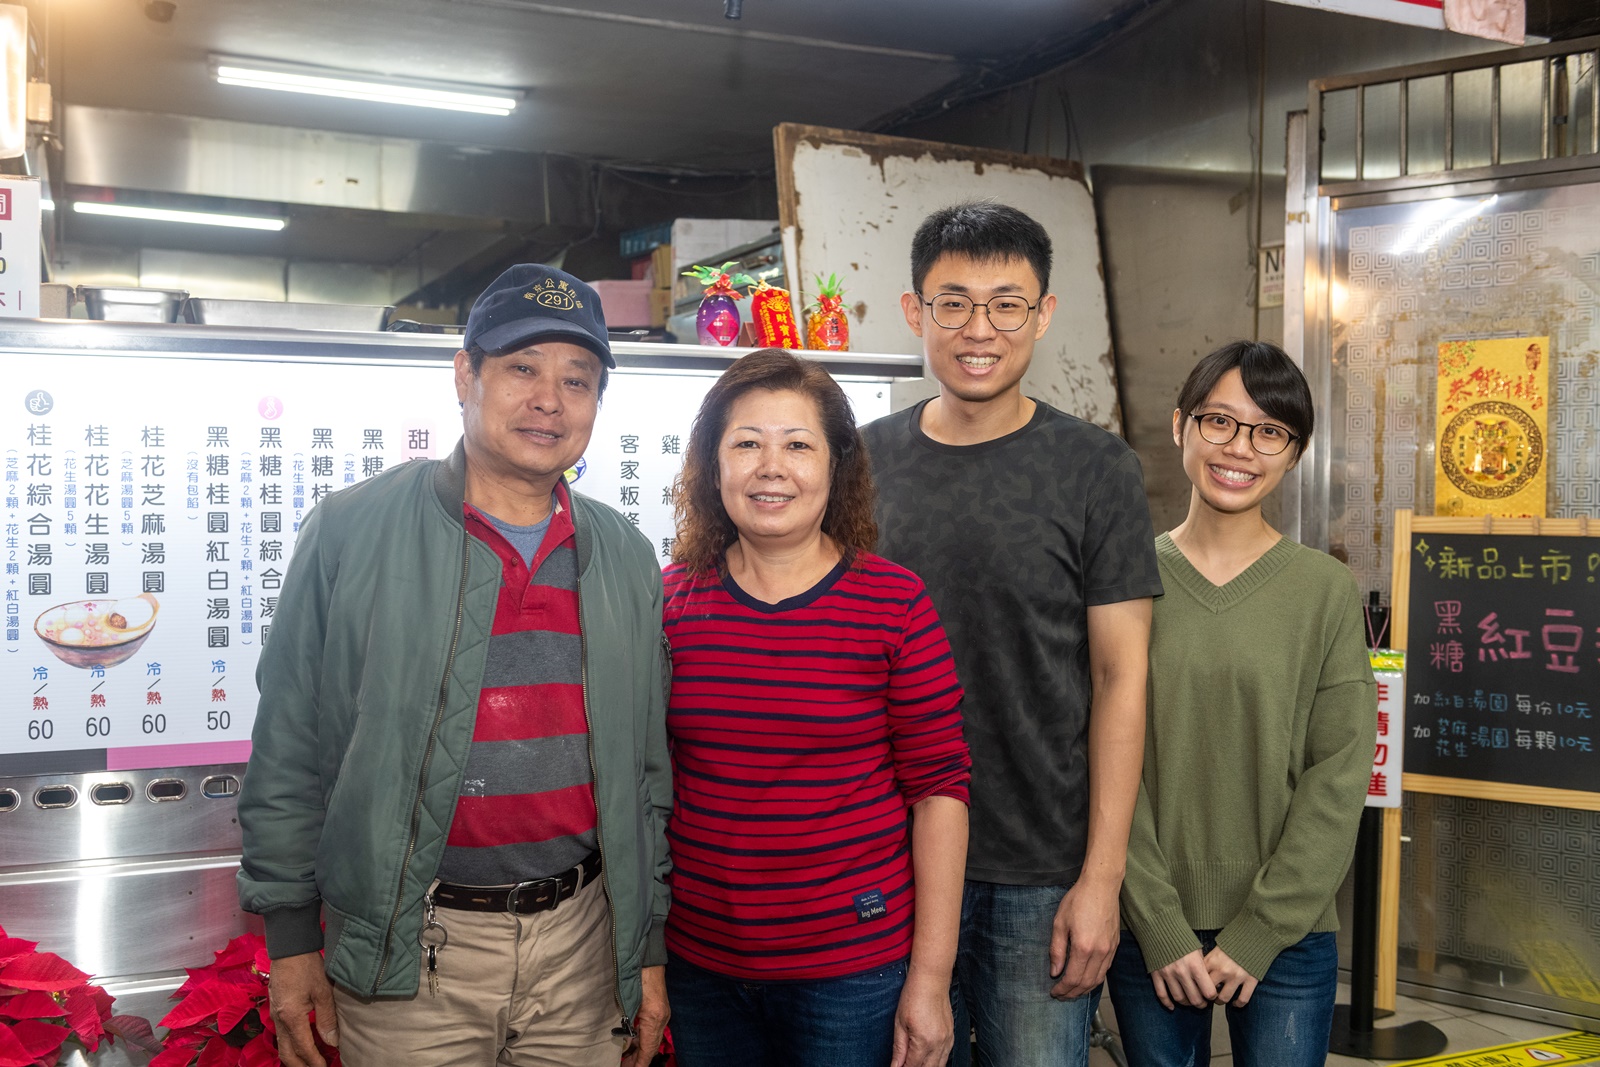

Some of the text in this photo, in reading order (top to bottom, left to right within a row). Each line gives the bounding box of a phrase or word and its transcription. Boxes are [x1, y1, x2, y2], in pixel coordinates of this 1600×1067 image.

[544, 294, 569, 307] 291
[26, 423, 52, 596] 桂花綜合湯圓
[84, 424, 110, 595] 桂花花生湯圓
[140, 425, 165, 594] 桂花芝麻湯圓
[206, 426, 230, 648] 黑糖桂圓紅白湯圓
[1430, 600, 1464, 673] 黑糖
[1477, 608, 1600, 674] 紅豆
[1413, 693, 1430, 705] 加
[28, 719, 54, 740] 60
[85, 716, 111, 737] 60
[142, 713, 166, 734] 60
[207, 710, 231, 730] 50
[1412, 725, 1430, 738] 加
